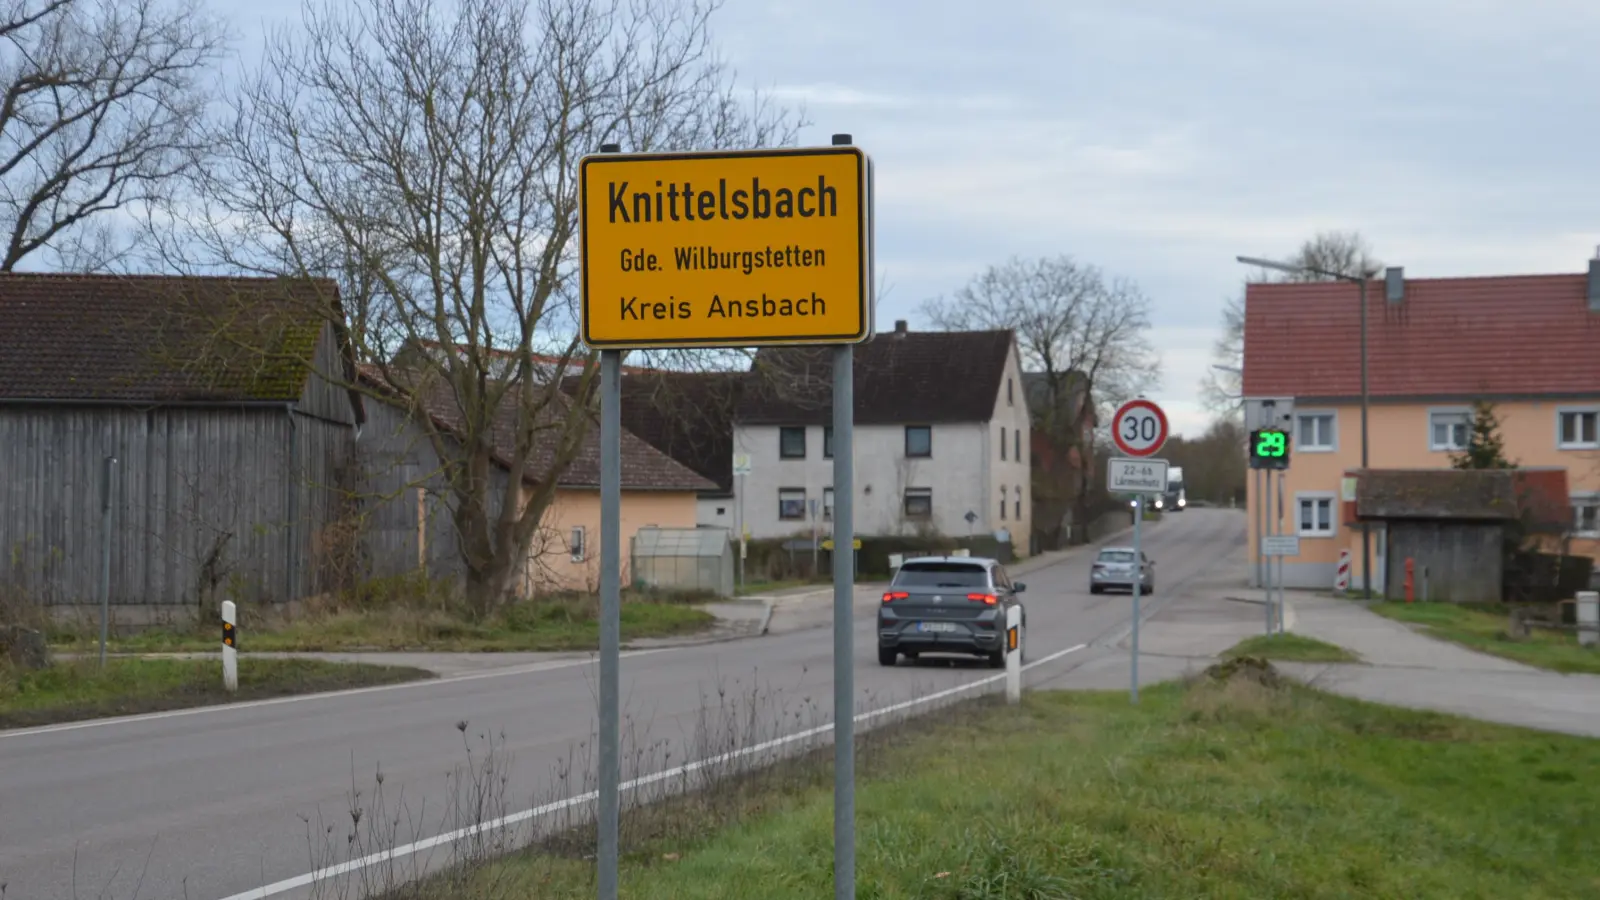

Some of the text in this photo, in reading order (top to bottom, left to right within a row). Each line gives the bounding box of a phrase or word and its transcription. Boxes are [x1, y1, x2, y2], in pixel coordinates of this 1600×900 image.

[608, 175, 837, 223] Knittelsbach
[620, 245, 826, 275] Gde. Wilburgstetten
[620, 292, 826, 320] Kreis Ansbach
[1123, 416, 1156, 442] 30
[1256, 432, 1286, 457] 29
